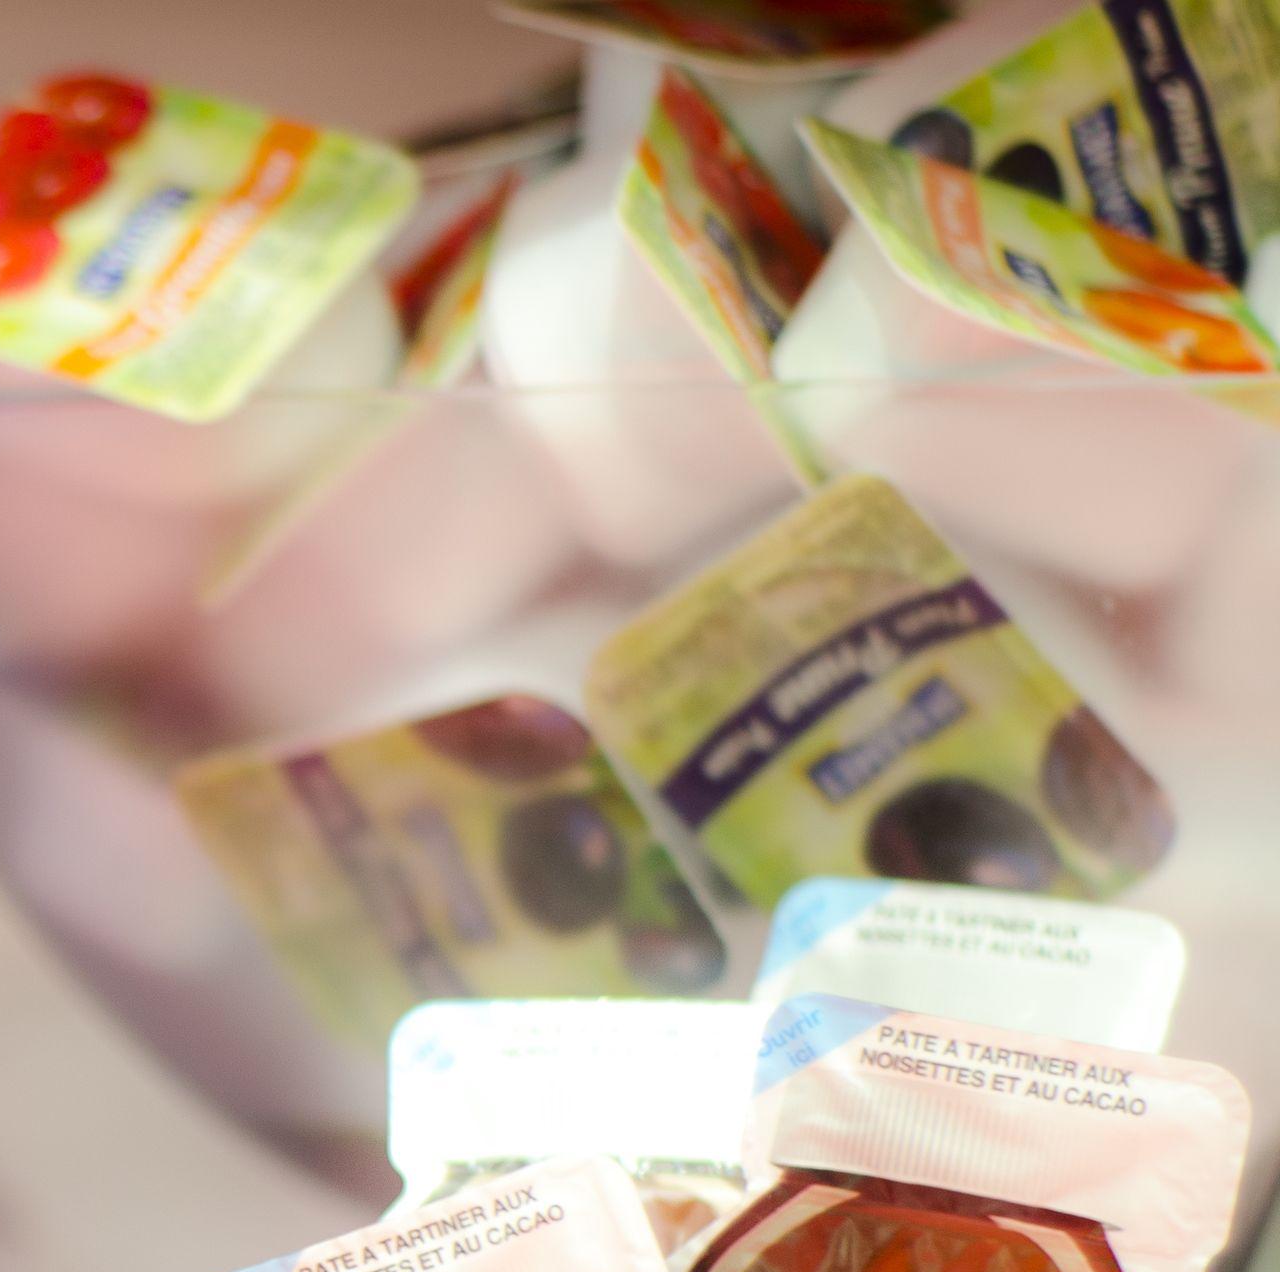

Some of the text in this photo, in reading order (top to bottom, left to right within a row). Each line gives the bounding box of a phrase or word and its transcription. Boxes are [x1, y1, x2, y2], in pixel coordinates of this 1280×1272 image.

[788, 1042, 813, 1065] ici
[861, 1049, 1146, 1117] NOISETTES ET AU CACAO
[879, 1027, 1132, 1088] PATE A TARTINER AUX
[360, 1246, 377, 1265] A
[380, 1206, 485, 1256] TARTINER
[493, 1187, 538, 1216] AUX
[419, 1248, 447, 1271] ET
[451, 1236, 483, 1260] AU
[487, 1205, 565, 1246] CACAO
